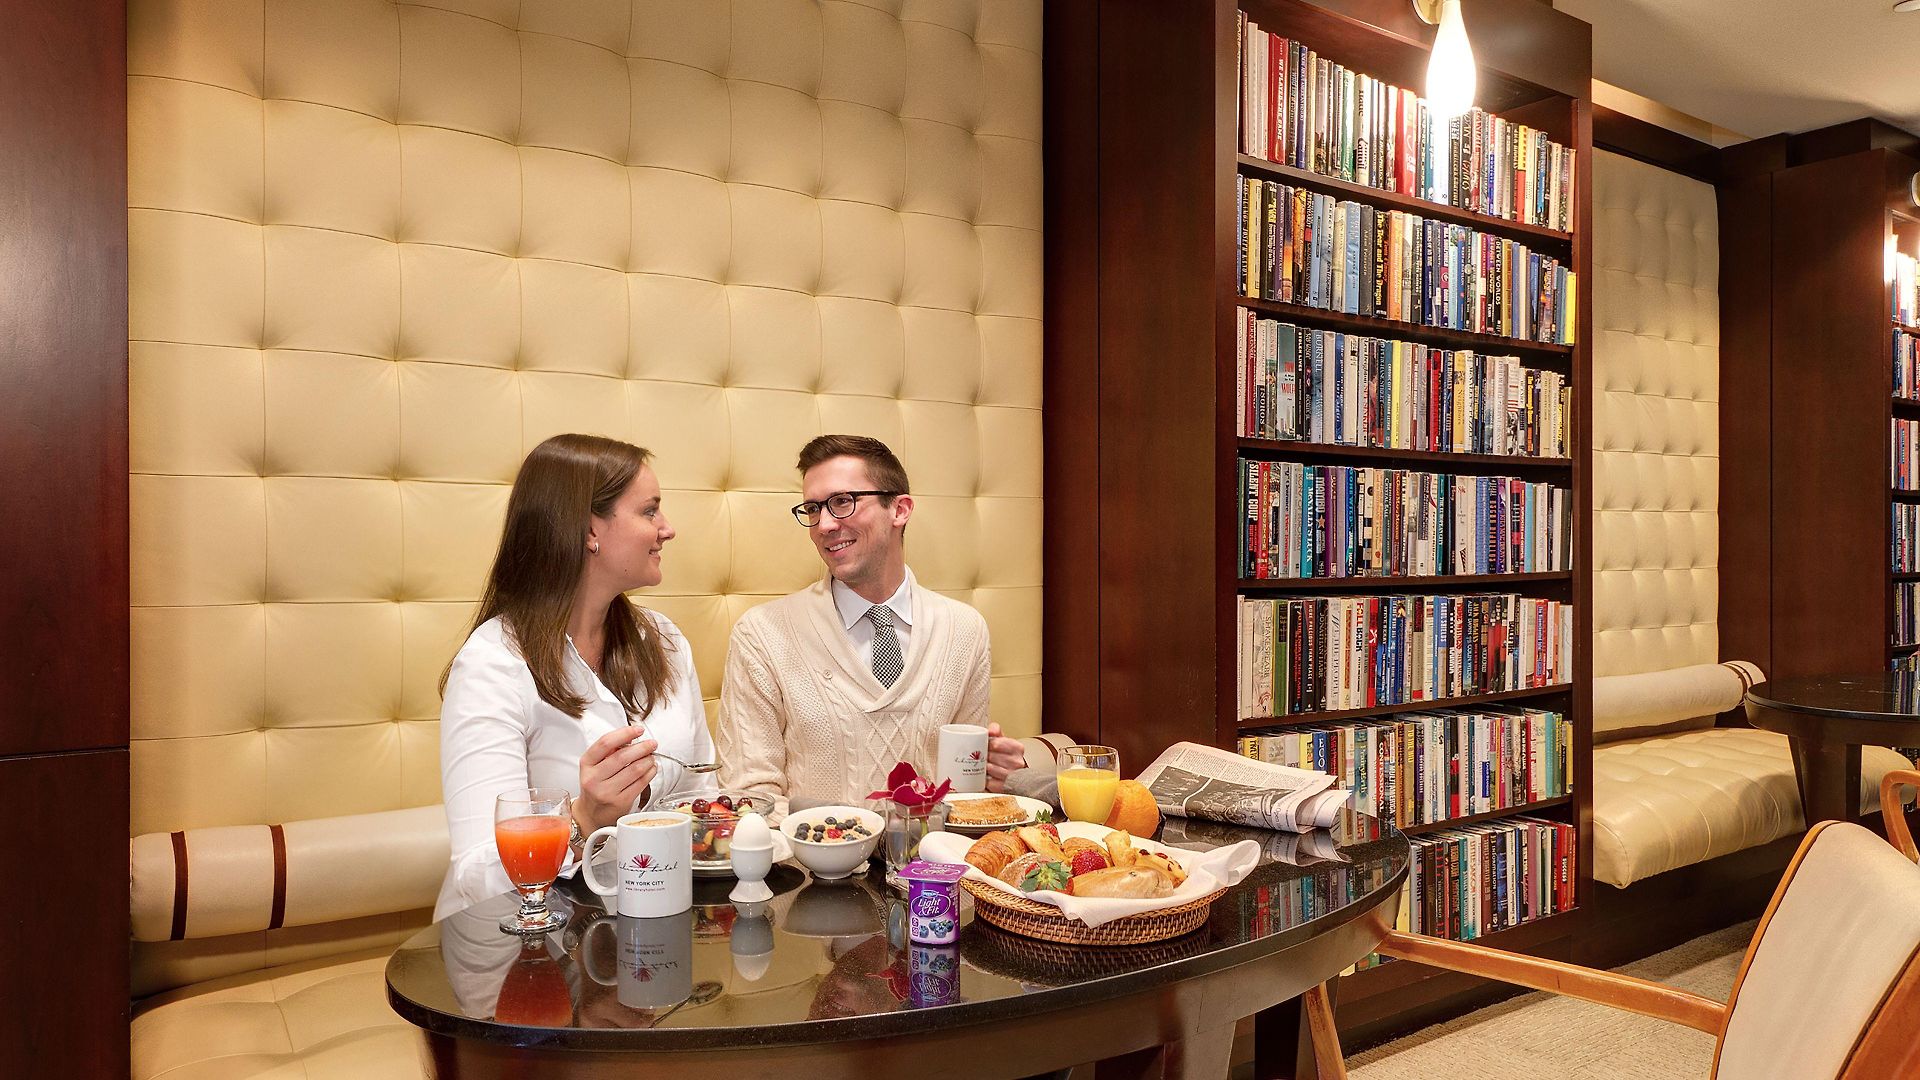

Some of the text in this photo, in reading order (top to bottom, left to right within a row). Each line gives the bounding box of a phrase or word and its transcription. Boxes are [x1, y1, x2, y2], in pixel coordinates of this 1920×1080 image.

[1278, 59, 1284, 72] WE
[1375, 280, 1383, 305] Dragon
[1248, 464, 1259, 521] SILENT COUP
[1315, 477, 1325, 513] MAMBO
[918, 898, 941, 908] Light
